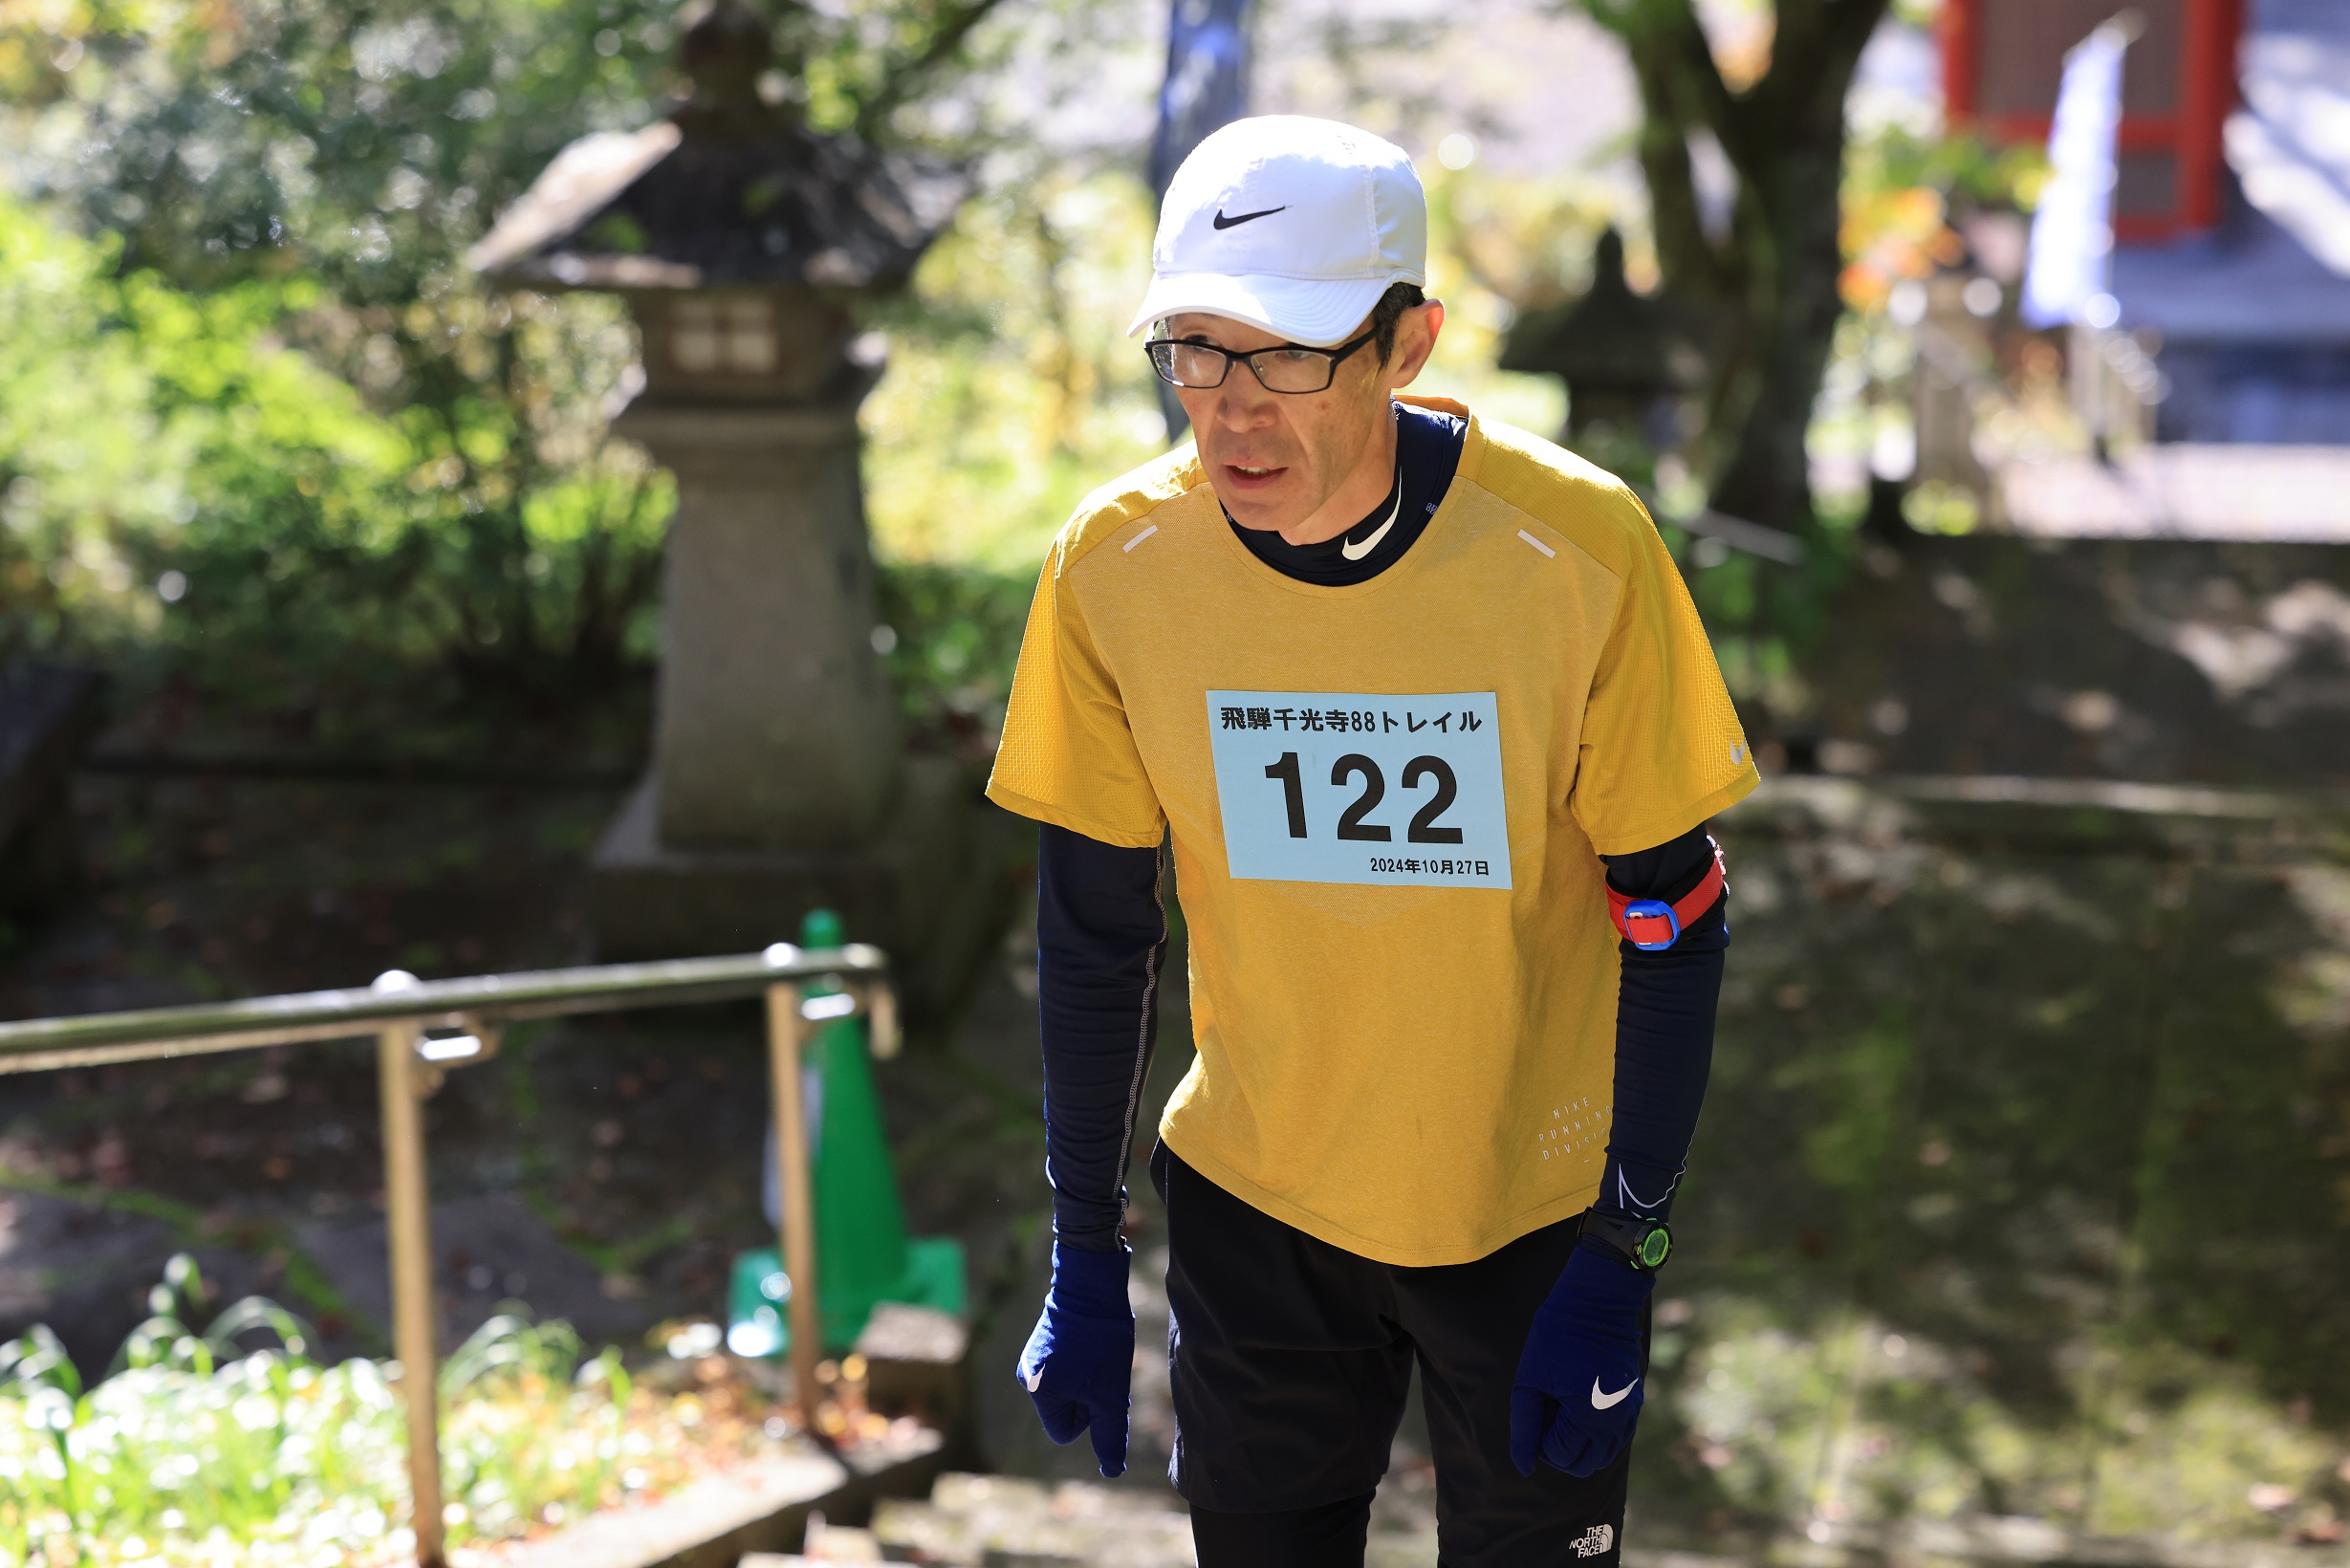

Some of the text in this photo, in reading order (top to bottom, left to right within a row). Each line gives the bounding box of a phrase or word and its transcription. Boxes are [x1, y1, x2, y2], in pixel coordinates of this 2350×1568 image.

[1220, 707, 1483, 733] 飛騨千光寺88トレイル
[1264, 751, 1464, 844] 122
[1370, 858, 1490, 876] 2024年10月27日
[1553, 1097, 1590, 1120] NIKE
[1538, 1105, 1613, 1143] RUNNING
[1542, 1127, 1607, 1161] DIVISIO
[1586, 1524, 1604, 1537] THE
[1568, 1535, 1602, 1550] NORTH
[1578, 1544, 1600, 1558] FACE
